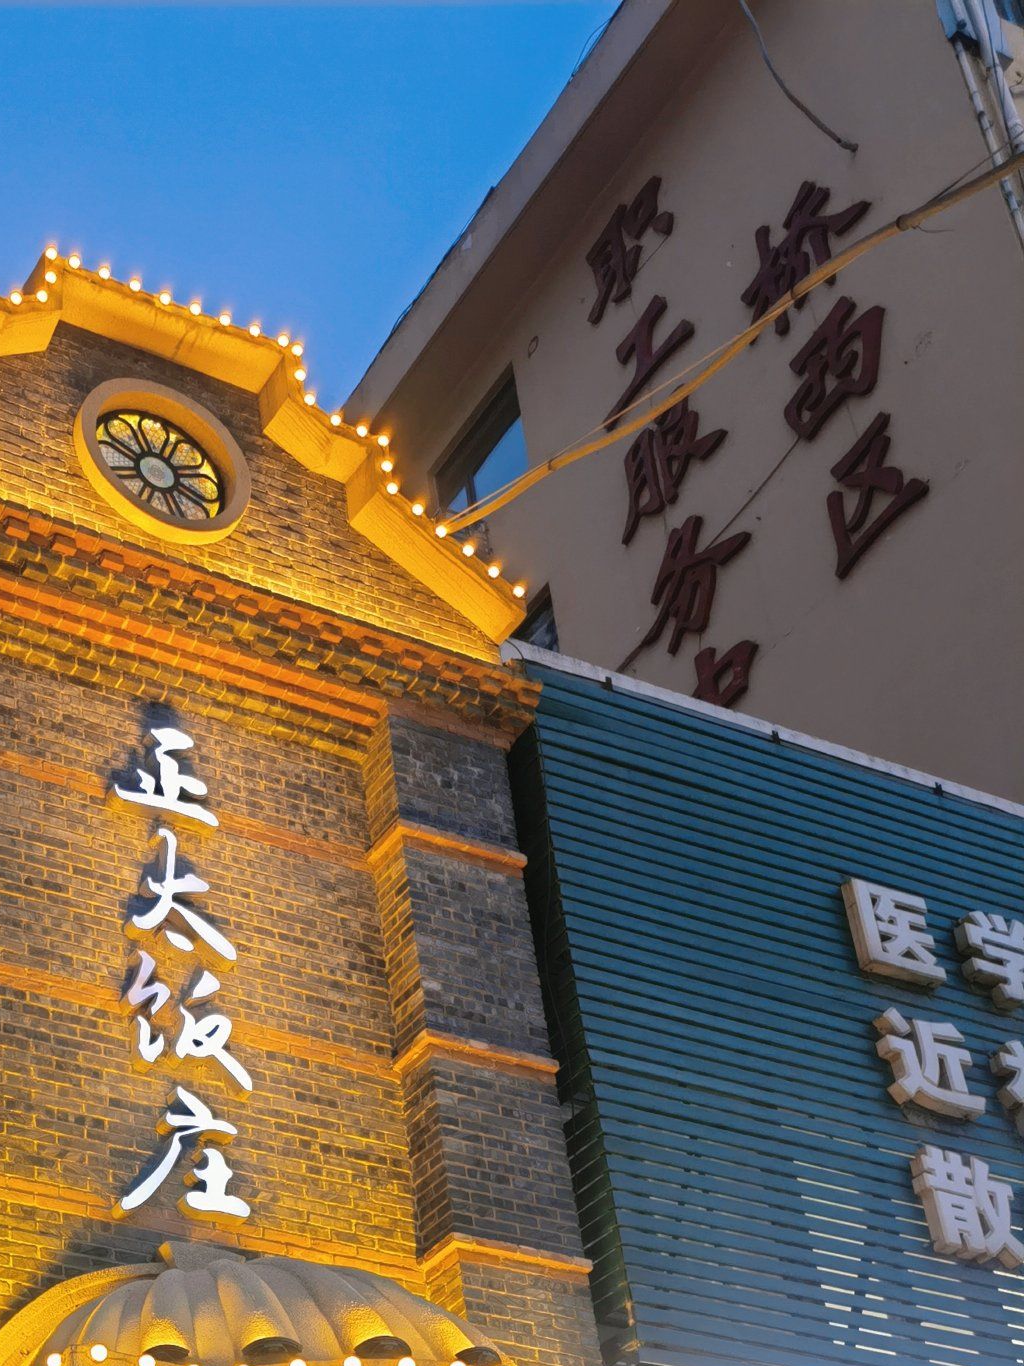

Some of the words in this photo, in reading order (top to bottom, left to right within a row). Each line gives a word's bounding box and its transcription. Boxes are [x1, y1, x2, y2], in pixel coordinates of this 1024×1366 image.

[113, 727, 253, 1218] 正太饭庄
[874, 1006, 1024, 1142] 近
[910, 1144, 1024, 1272] 散
